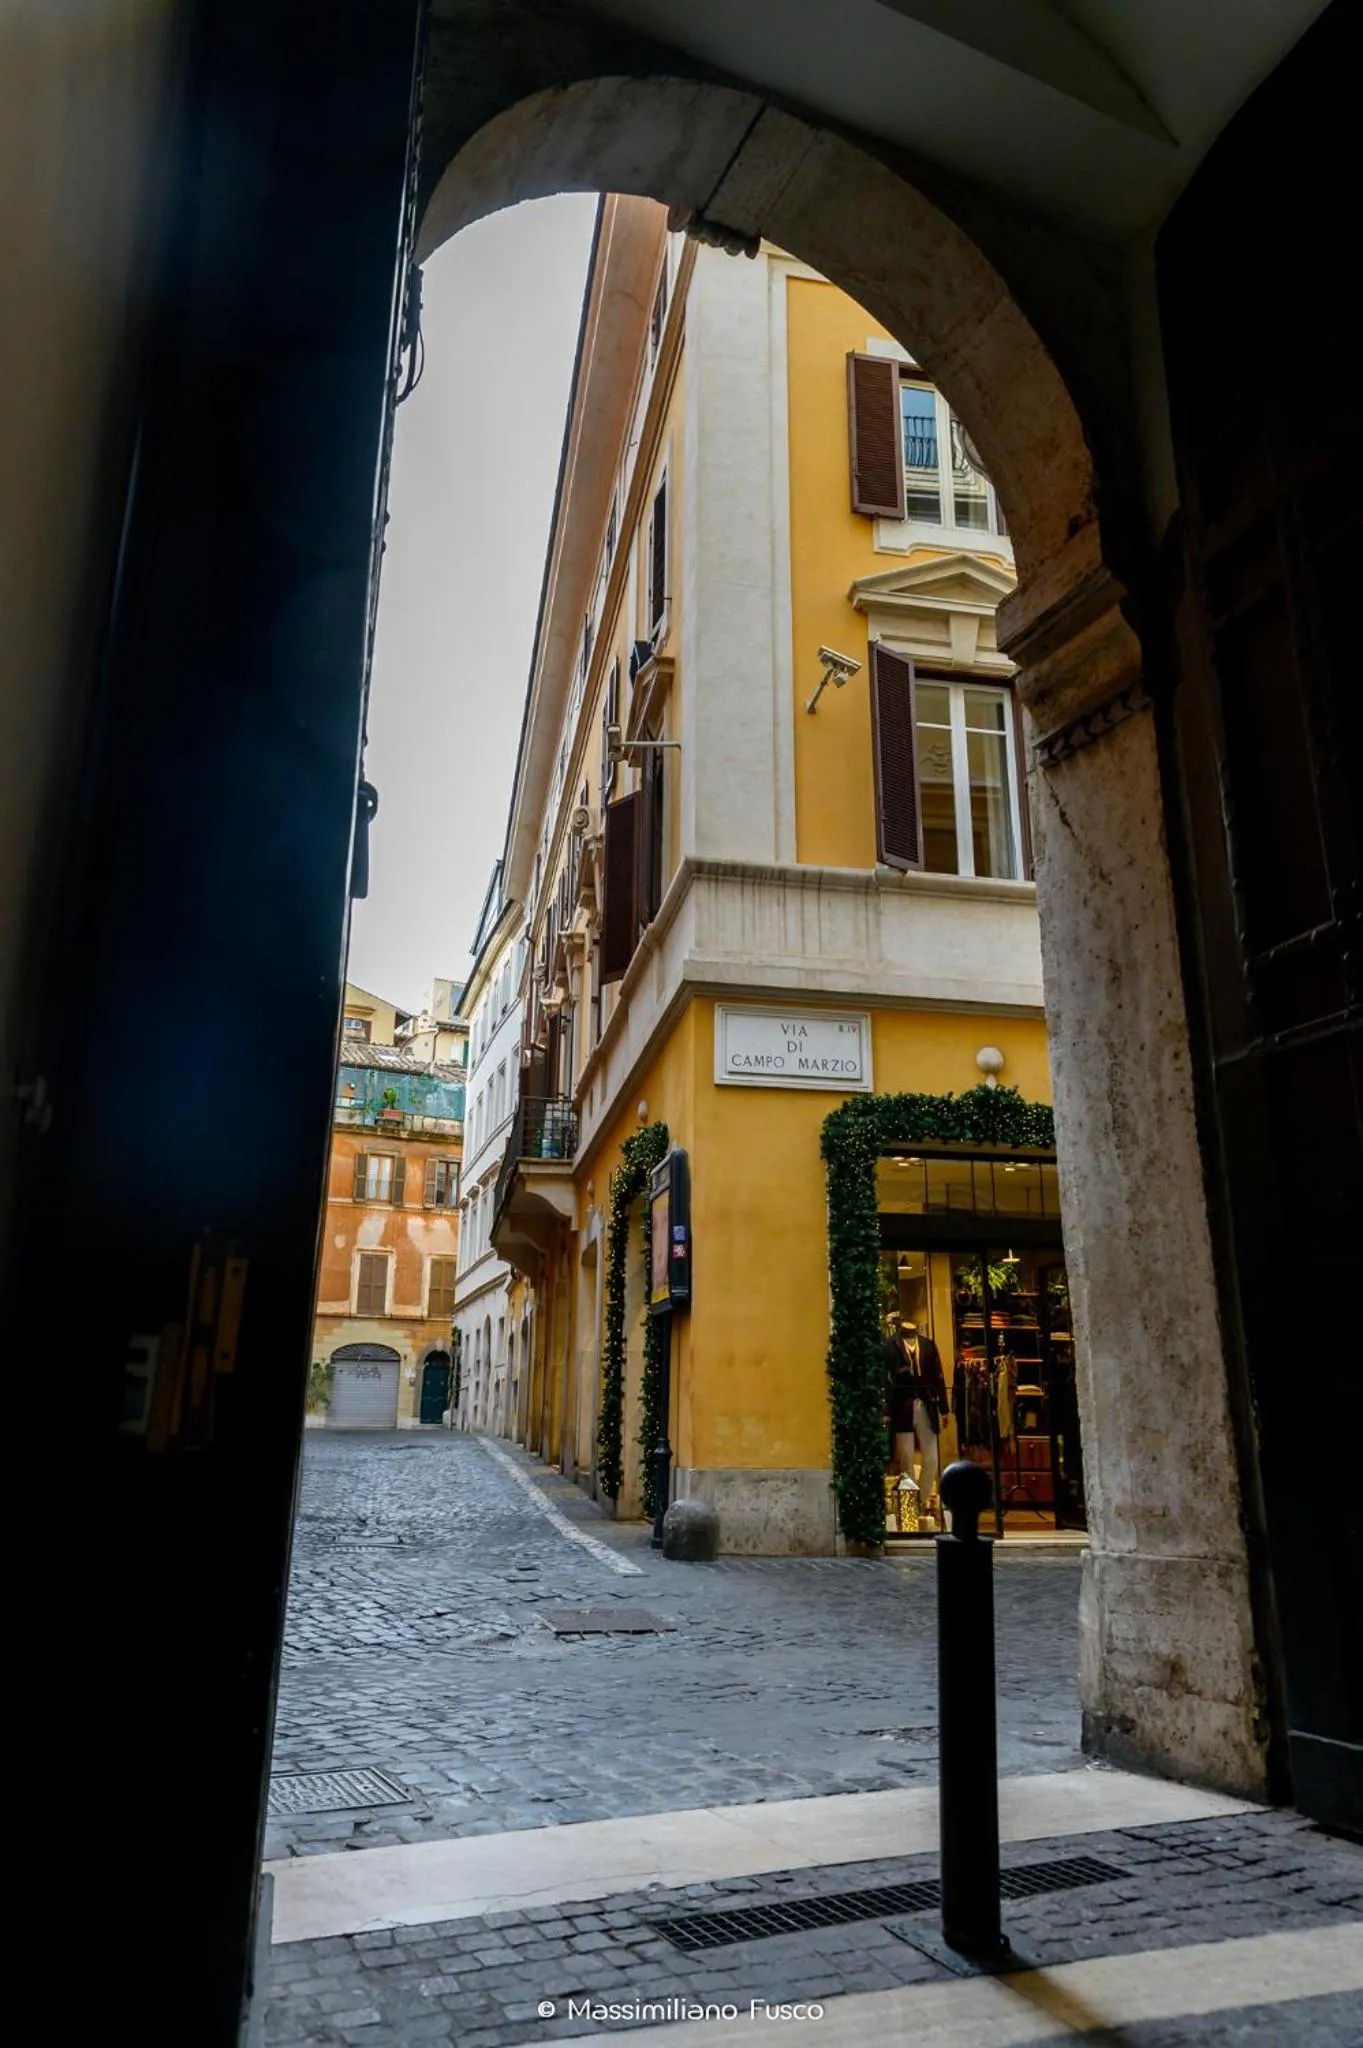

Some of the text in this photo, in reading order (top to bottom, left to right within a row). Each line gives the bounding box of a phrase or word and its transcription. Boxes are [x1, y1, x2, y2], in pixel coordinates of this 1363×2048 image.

[780, 1023, 808, 1037] VIA
[787, 1040, 803, 1053] DI
[731, 1054, 857, 1073] CAMPO MARZIO
